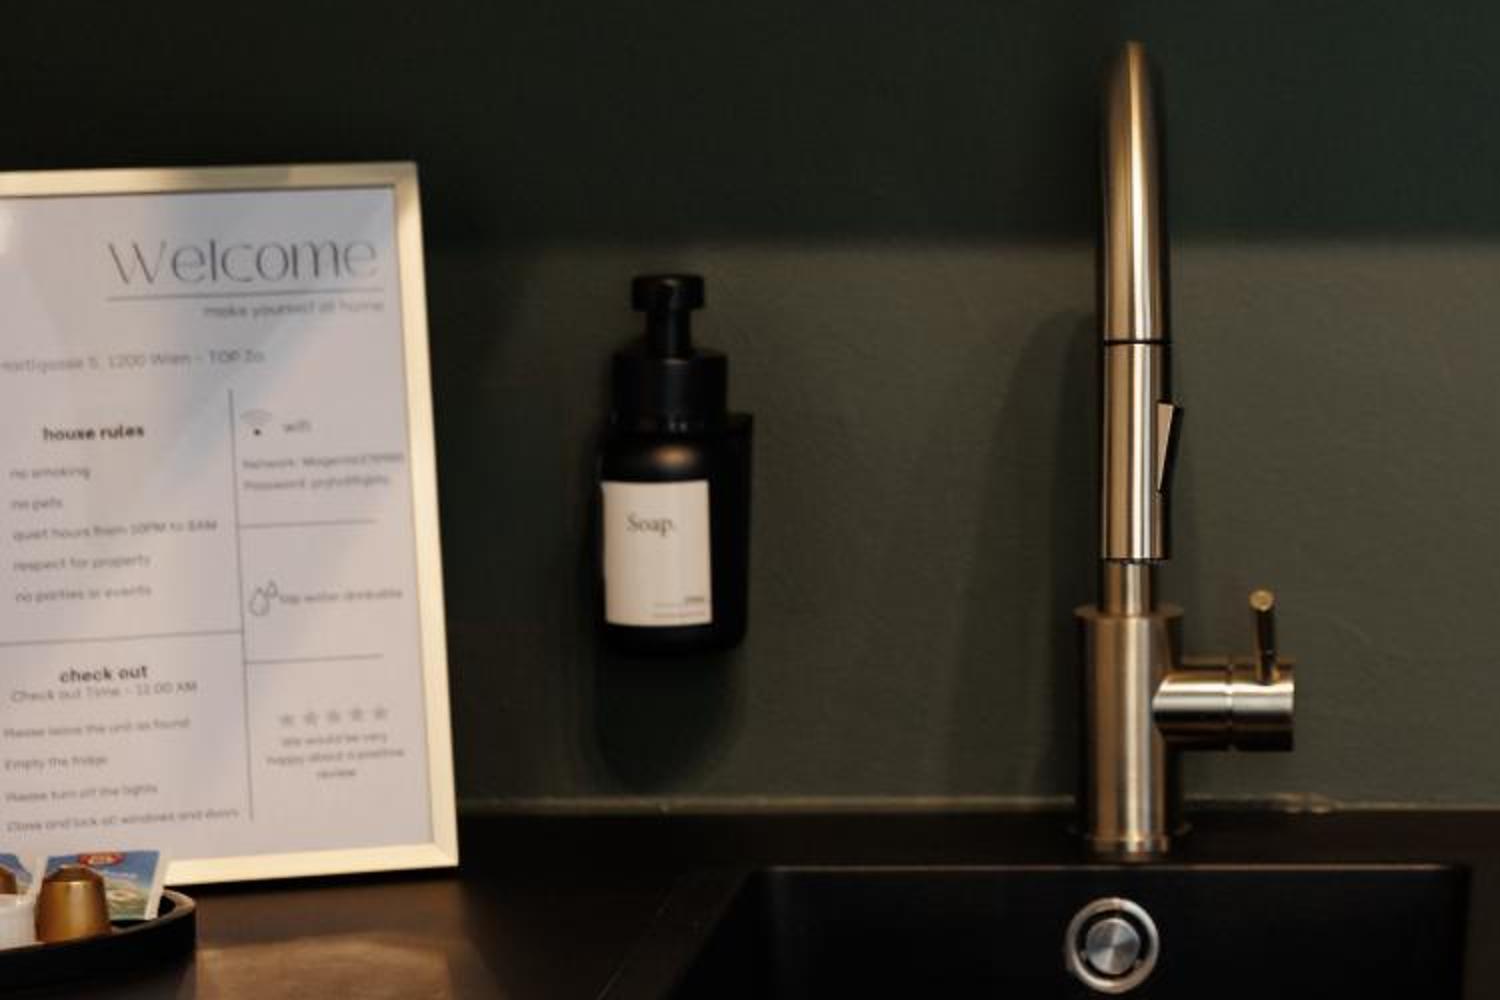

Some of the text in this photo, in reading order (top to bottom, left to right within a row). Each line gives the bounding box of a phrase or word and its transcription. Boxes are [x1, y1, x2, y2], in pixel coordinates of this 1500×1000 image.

[108, 238, 377, 285] Welcome
[43, 424, 146, 441] house rules
[59, 664, 149, 684] check out
